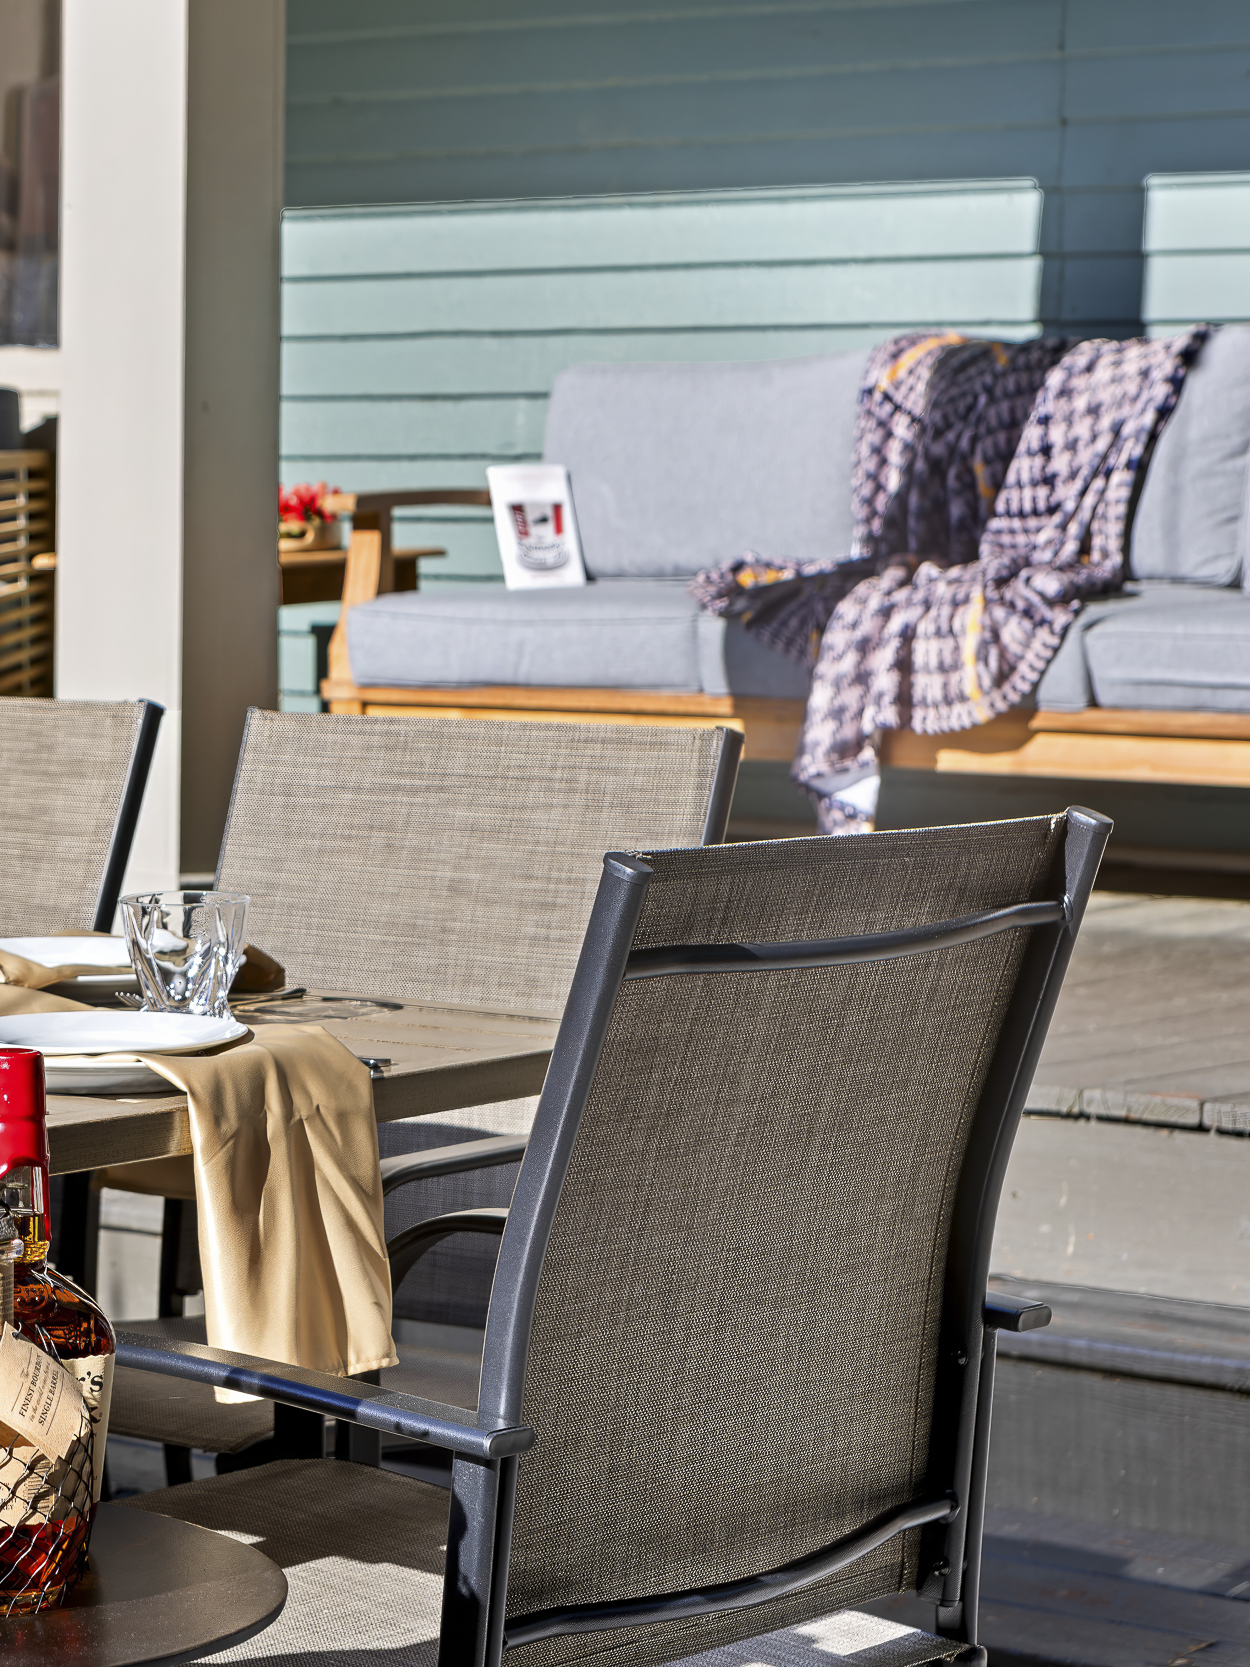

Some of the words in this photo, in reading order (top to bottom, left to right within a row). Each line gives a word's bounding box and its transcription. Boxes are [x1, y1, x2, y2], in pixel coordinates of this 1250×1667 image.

[19, 1387, 35, 1417] FINEST
[31, 1353, 42, 1387] BOURBON
[38, 1394, 54, 1426] SINGLE
[49, 1370, 59, 1393] BARREL
